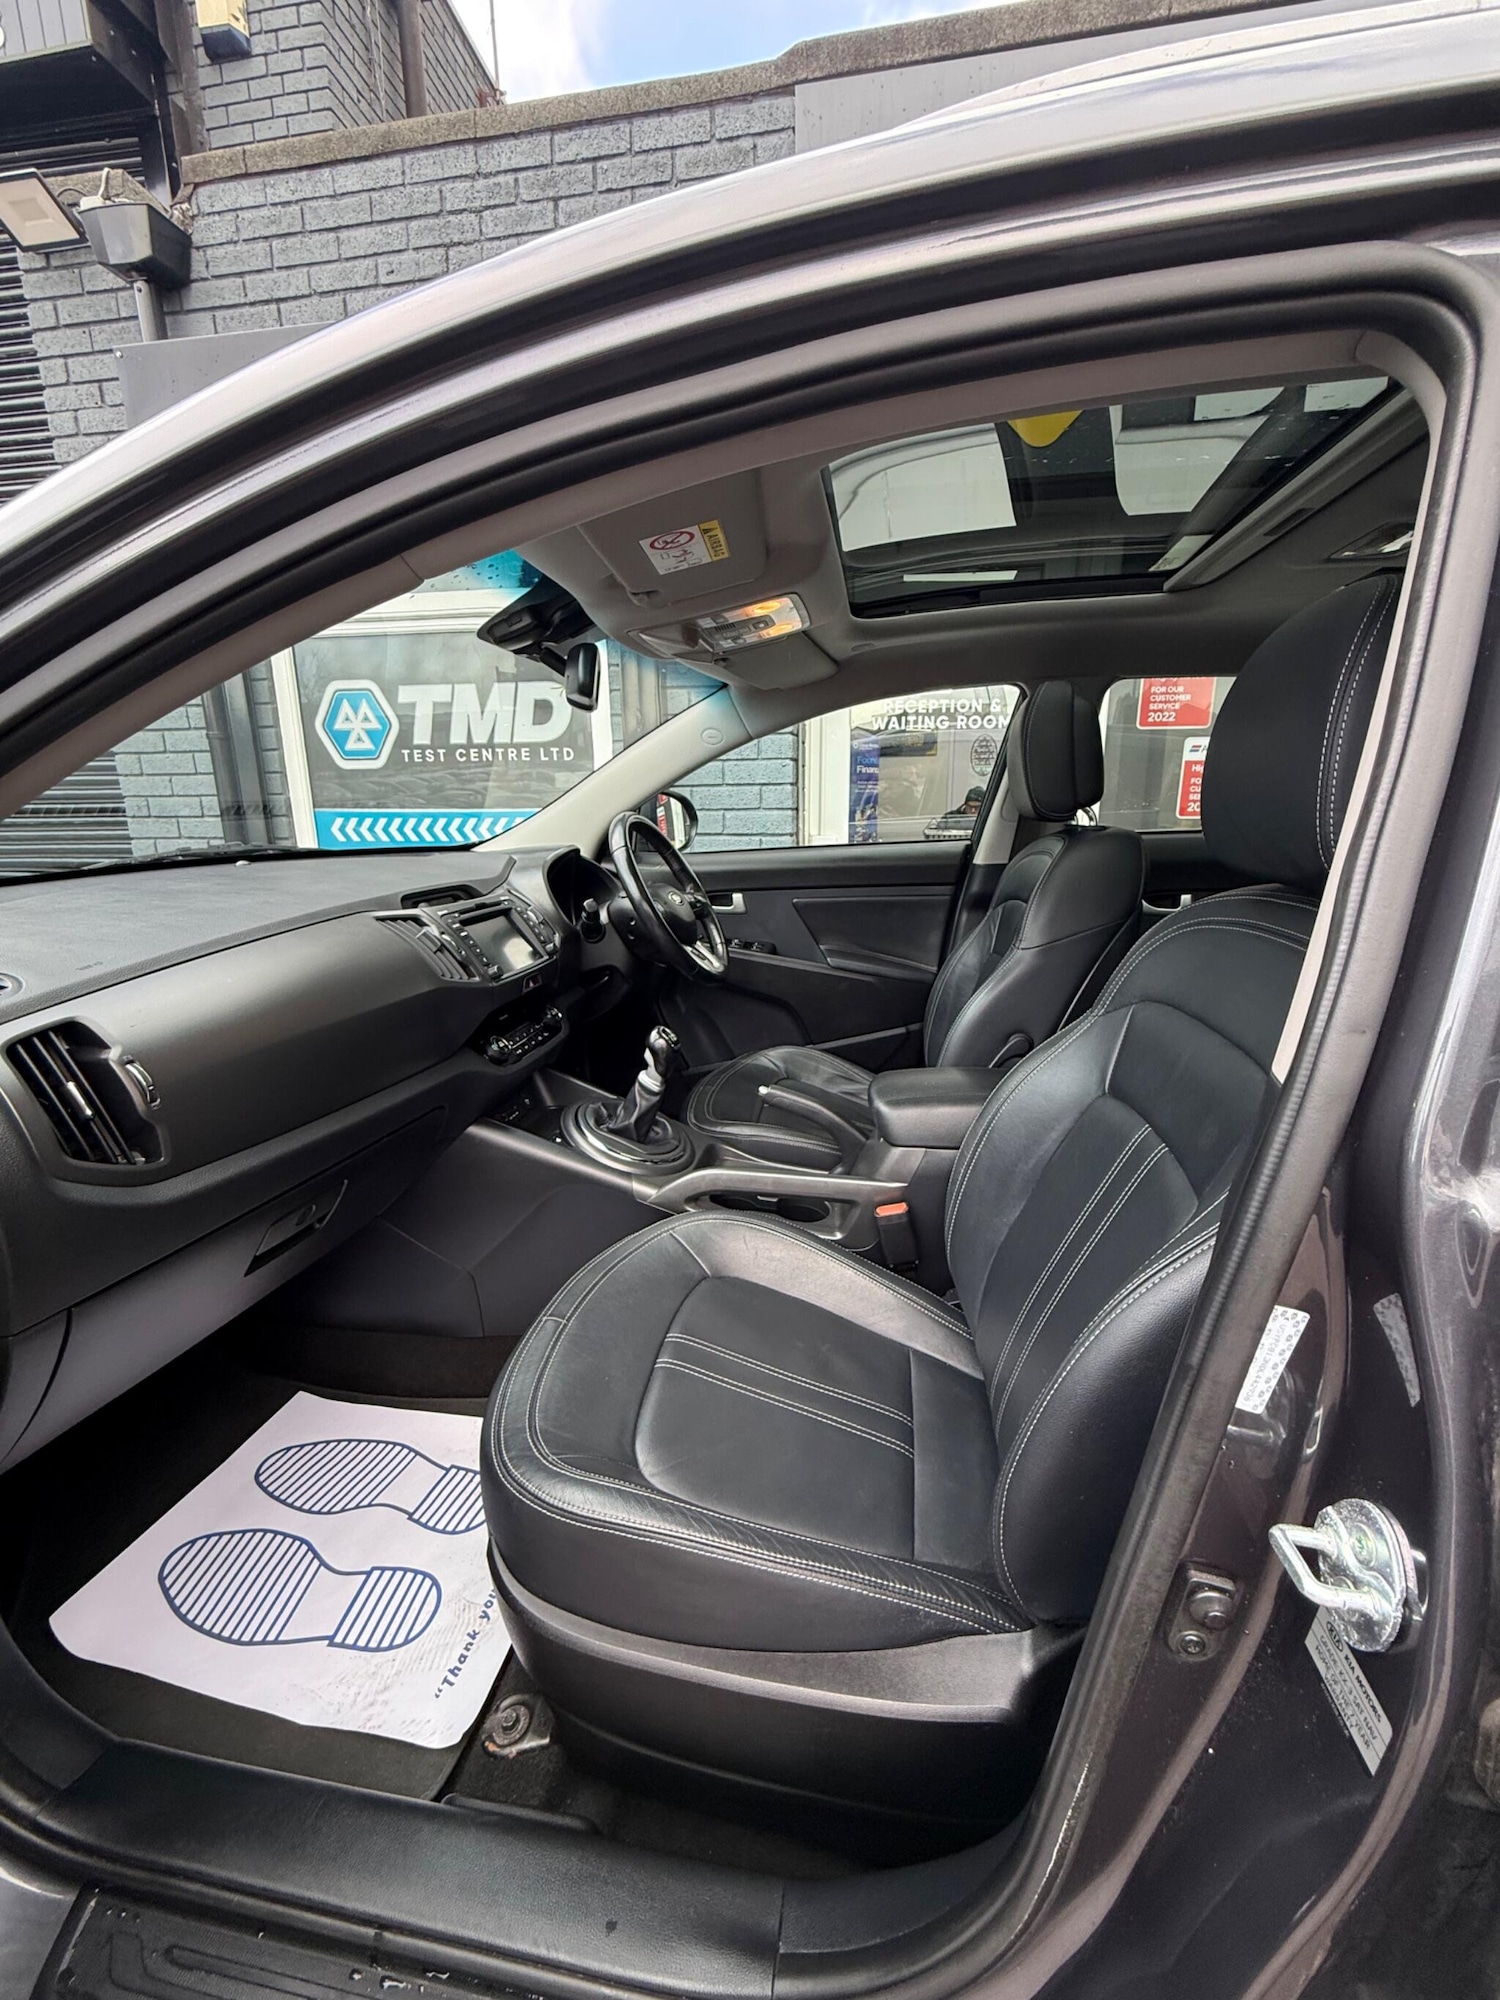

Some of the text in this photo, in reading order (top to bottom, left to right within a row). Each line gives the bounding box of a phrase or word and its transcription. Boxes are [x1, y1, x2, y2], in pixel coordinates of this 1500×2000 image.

[707, 533, 726, 558] AIRBAG
[1150, 694, 1192, 702] CUSTOMER
[398, 681, 573, 745] TMD
[884, 699, 1002, 713] RECEPTION &
[871, 716, 950, 731] WAITING
[1147, 711, 1176, 722] 2022
[401, 747, 575, 762] TEST CENTRE LTD
[1344, 1654, 1382, 1723] KIA MOTORS
